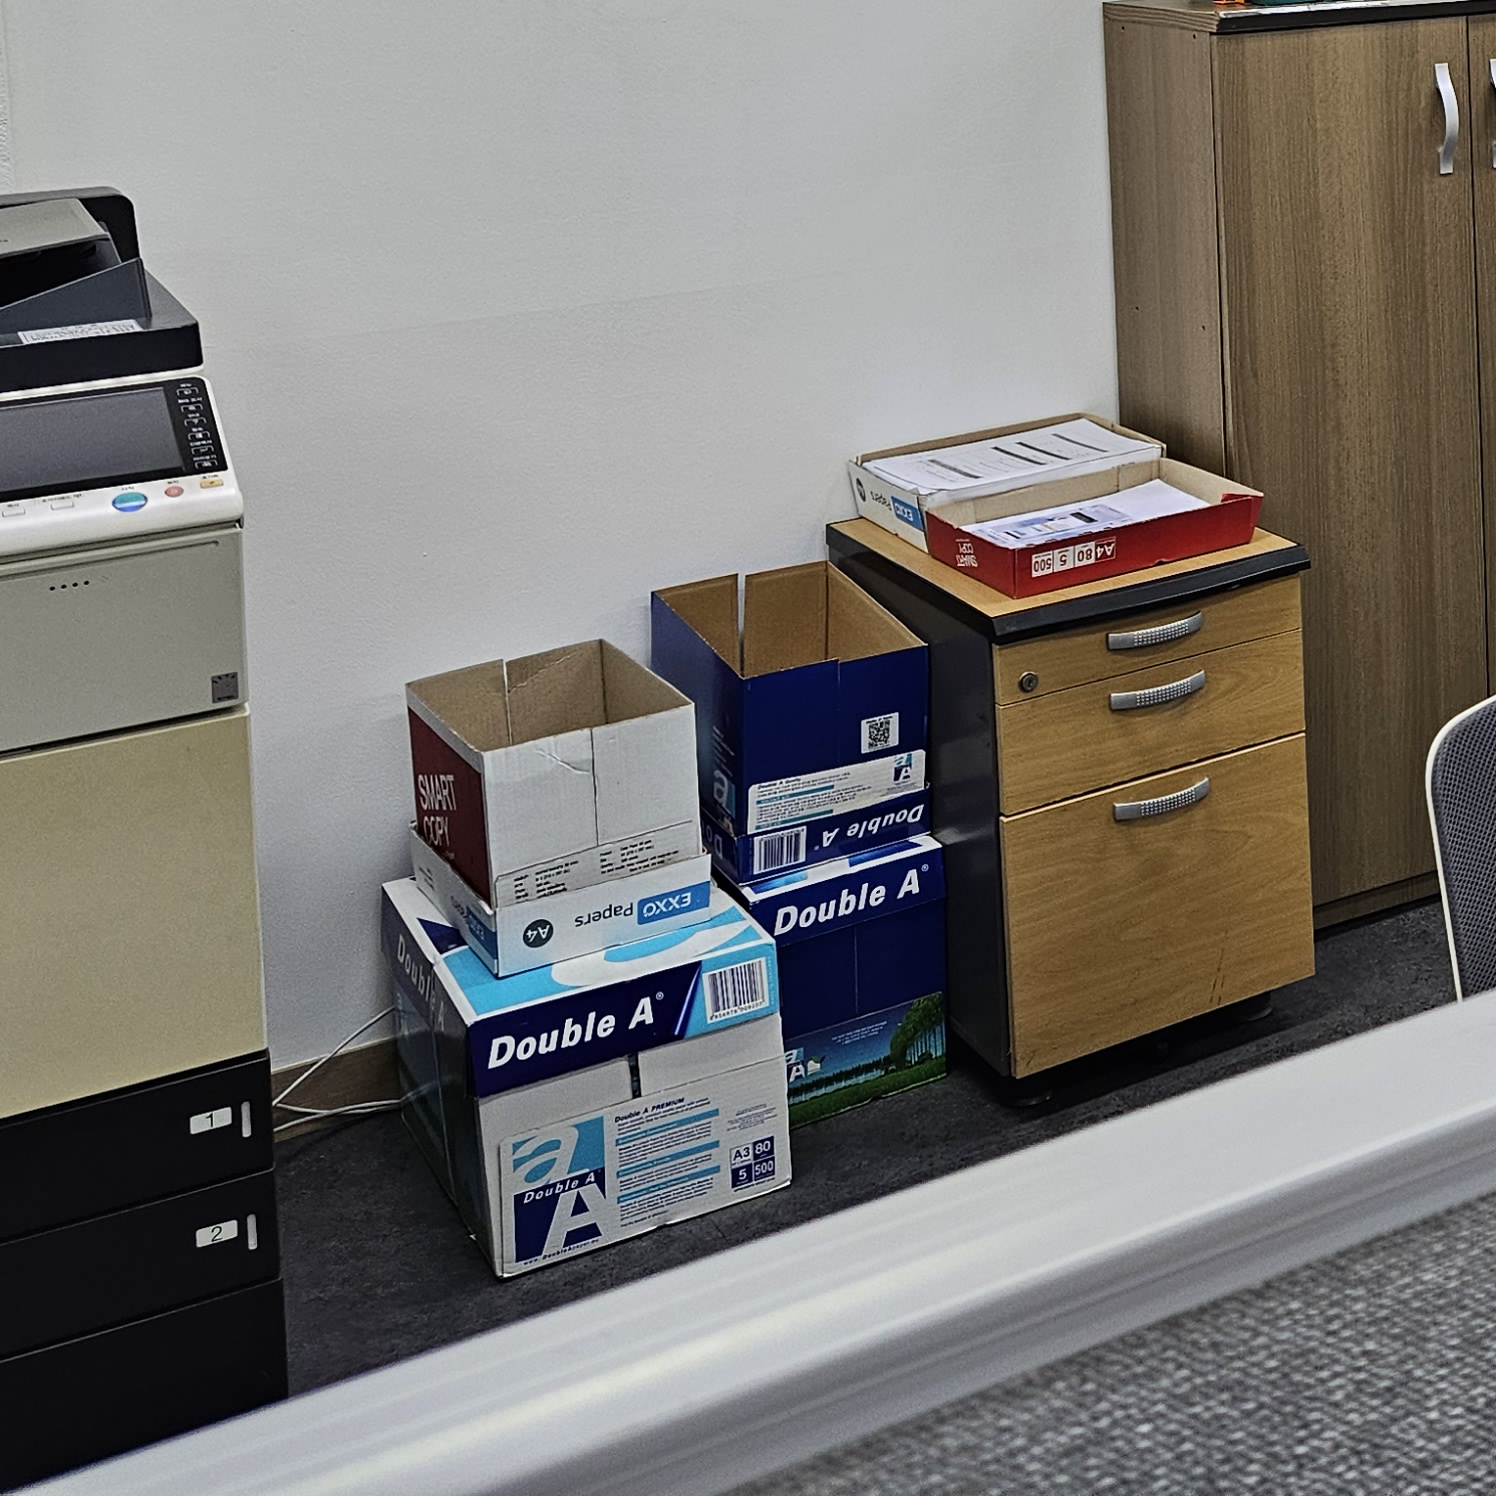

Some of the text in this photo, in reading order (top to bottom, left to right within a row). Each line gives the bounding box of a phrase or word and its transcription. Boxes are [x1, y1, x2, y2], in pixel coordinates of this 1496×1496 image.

[1033, 541, 1116, 573] A4 80 5 500
[417, 774, 457, 811] SMART
[423, 816, 450, 847] COPY
[846, 804, 925, 839] Double
[822, 827, 840, 848] A
[574, 892, 692, 927] EXXO Papers
[773, 868, 921, 936] Double A
[525, 923, 551, 943] A4
[487, 997, 654, 1069] Double A
[205, 1113, 214, 1128] 1
[615, 1110, 641, 1123] Double
[651, 1097, 685, 1112] PREMIUM
[733, 1140, 771, 1162] A3 80
[739, 1160, 774, 1180] 5 500
[523, 1172, 595, 1204] Double A
[211, 1226, 223, 1242] 2
